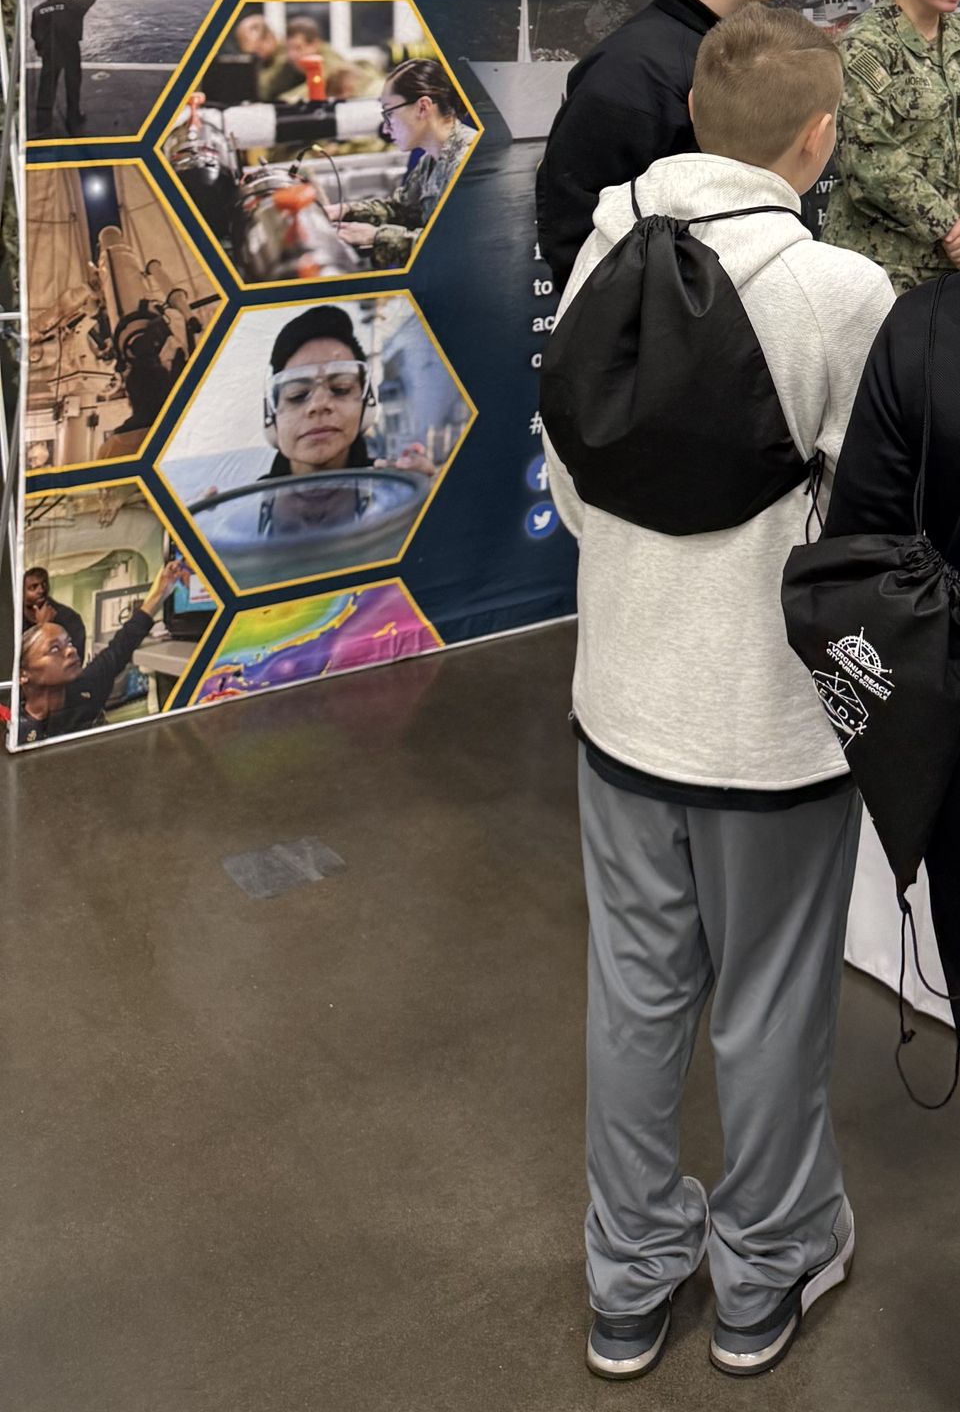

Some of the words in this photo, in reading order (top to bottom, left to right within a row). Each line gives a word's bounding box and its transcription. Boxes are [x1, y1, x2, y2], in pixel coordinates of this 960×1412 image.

[826, 648, 840, 662] CITY
[838, 659, 860, 681] PUBLIC
[858, 677, 888, 701] SCHOOLS
[832, 645, 864, 678] VIRGINIA
[863, 674, 892, 698] BEACH
